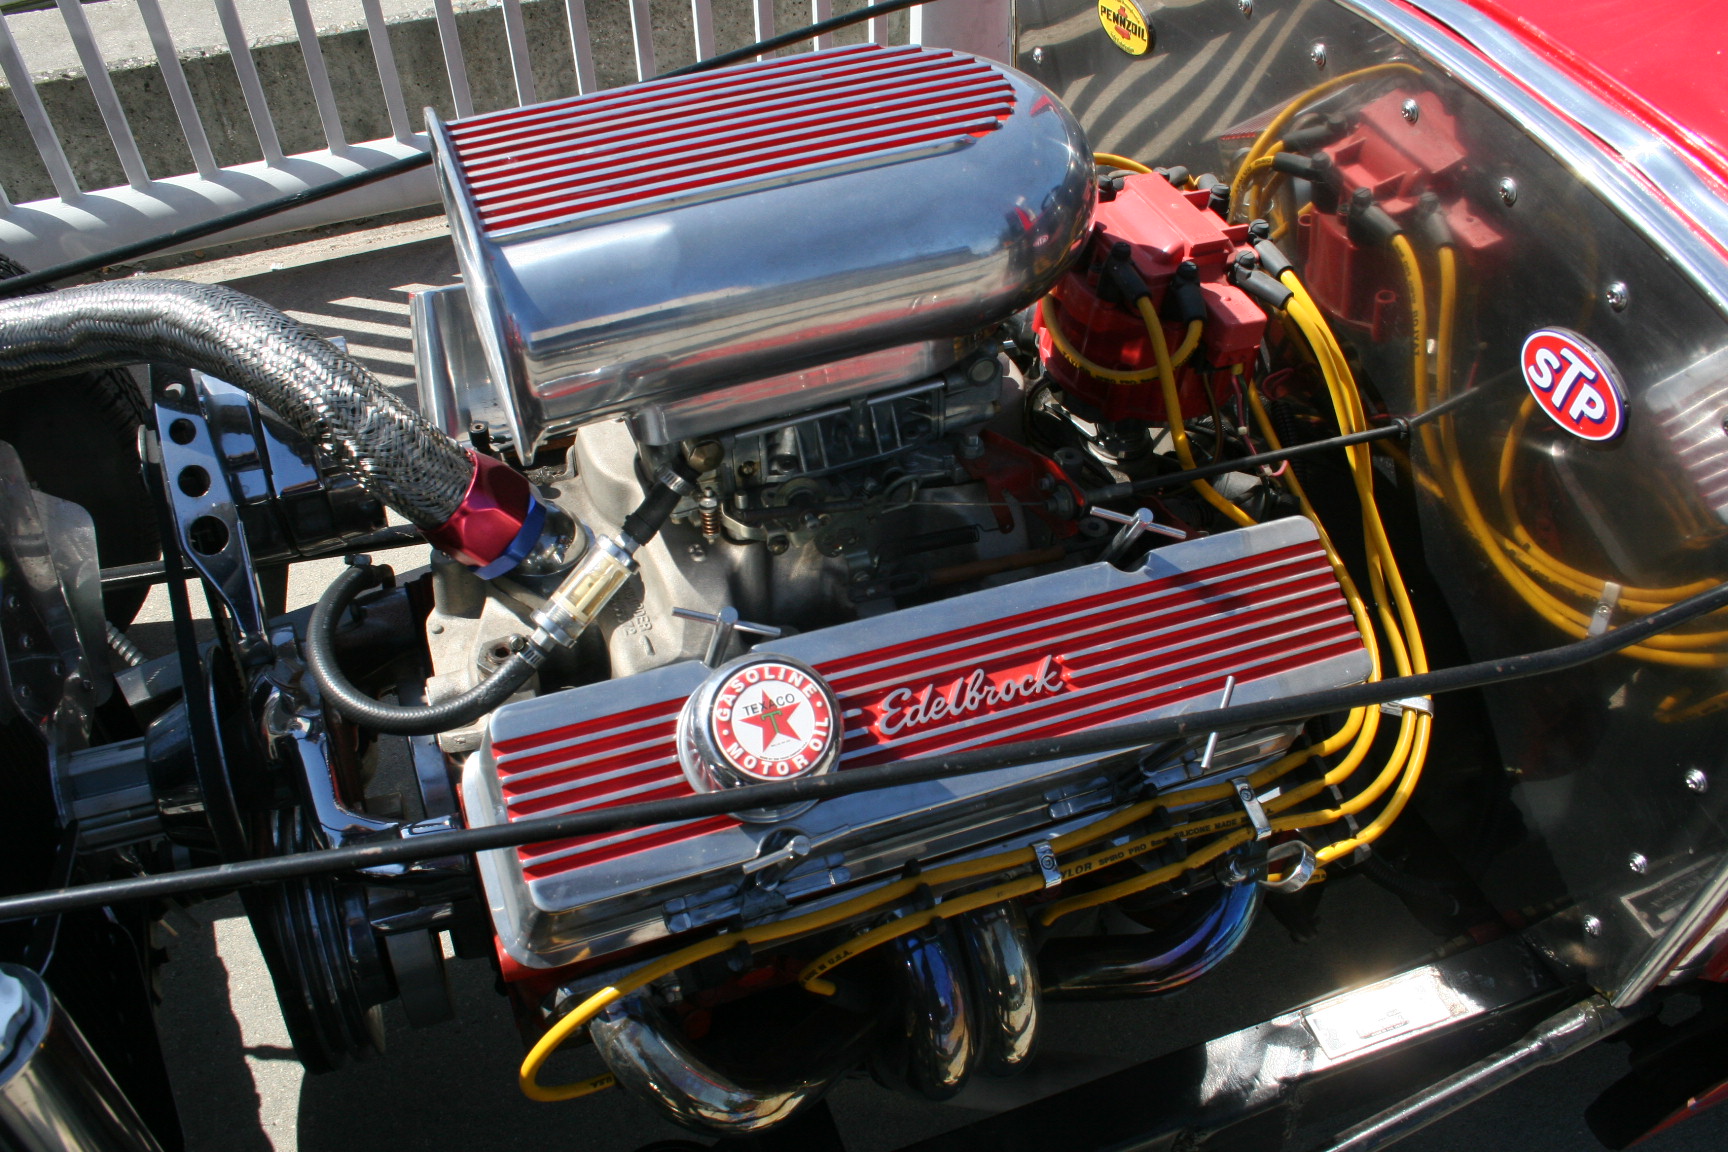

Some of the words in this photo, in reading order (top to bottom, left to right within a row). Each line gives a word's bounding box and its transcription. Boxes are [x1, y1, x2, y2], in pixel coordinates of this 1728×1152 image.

[1100, 5, 1147, 41] PENNZOIL
[1528, 347, 1606, 422] STP
[716, 666, 817, 721] GASOLINE
[742, 693, 795, 717] TEXACO
[761, 710, 782, 733] T
[878, 654, 1063, 735] Edelbrock
[726, 742, 809, 775] MOTOR
[809, 717, 829, 751] OIL
[1061, 862, 1092, 879] YLOR
[1128, 843, 1147, 855] PRO
[1174, 824, 1211, 838] SILICONE
[1214, 819, 1238, 830] MADE
